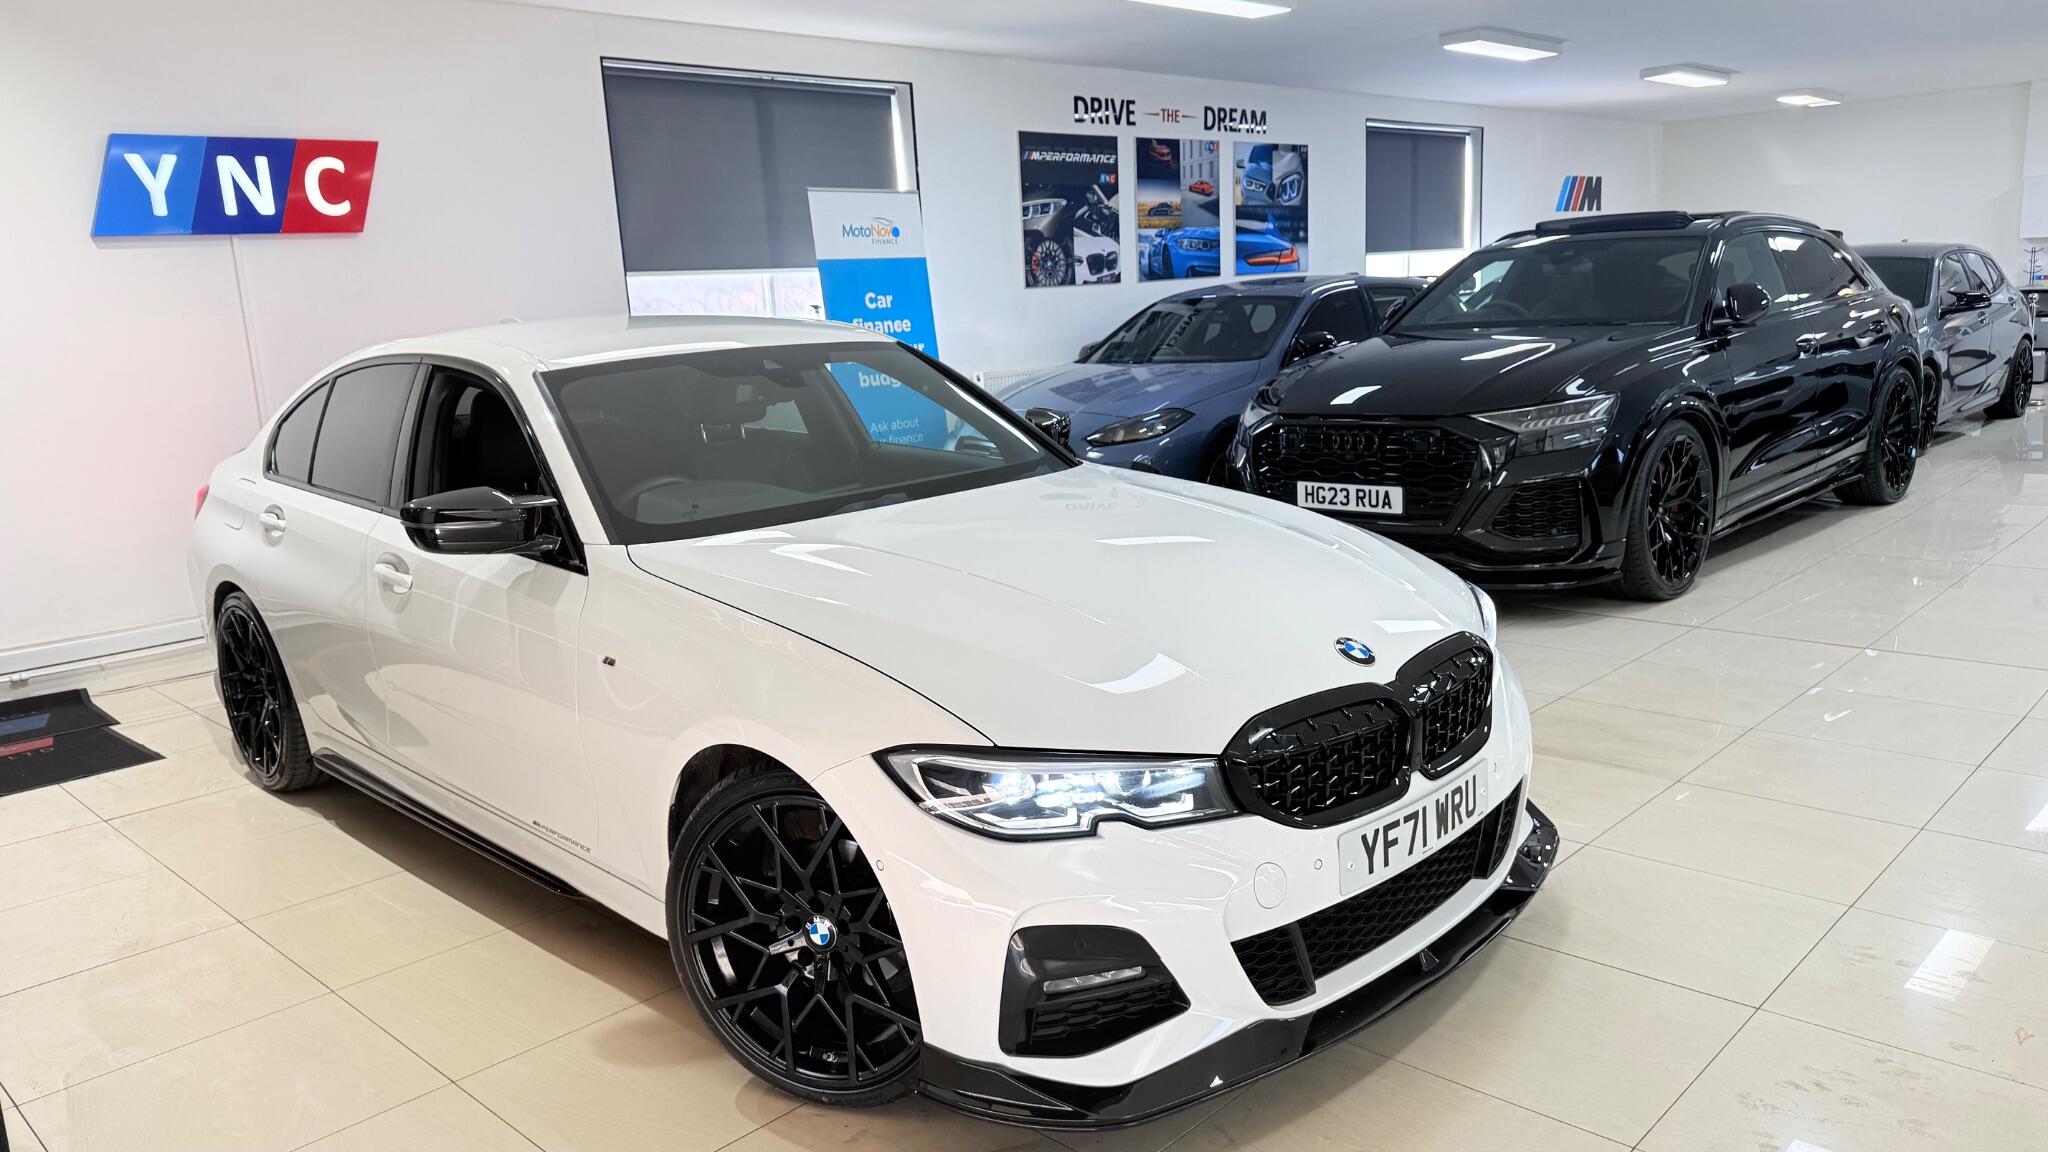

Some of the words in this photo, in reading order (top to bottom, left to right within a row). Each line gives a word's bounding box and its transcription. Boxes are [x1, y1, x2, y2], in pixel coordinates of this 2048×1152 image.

[1073, 95, 1137, 126] DRIVE
[1160, 108, 1181, 123] THE
[1203, 105, 1267, 134] DREAM
[124, 153, 351, 217] YNC
[865, 292, 893, 309] Car
[870, 421, 889, 433] Ask
[891, 418, 919, 431] about
[1305, 485, 1350, 506] HG23
[1355, 489, 1392, 509] RUA
[1361, 806, 1427, 875] YF71
[1436, 775, 1476, 840] WRU
